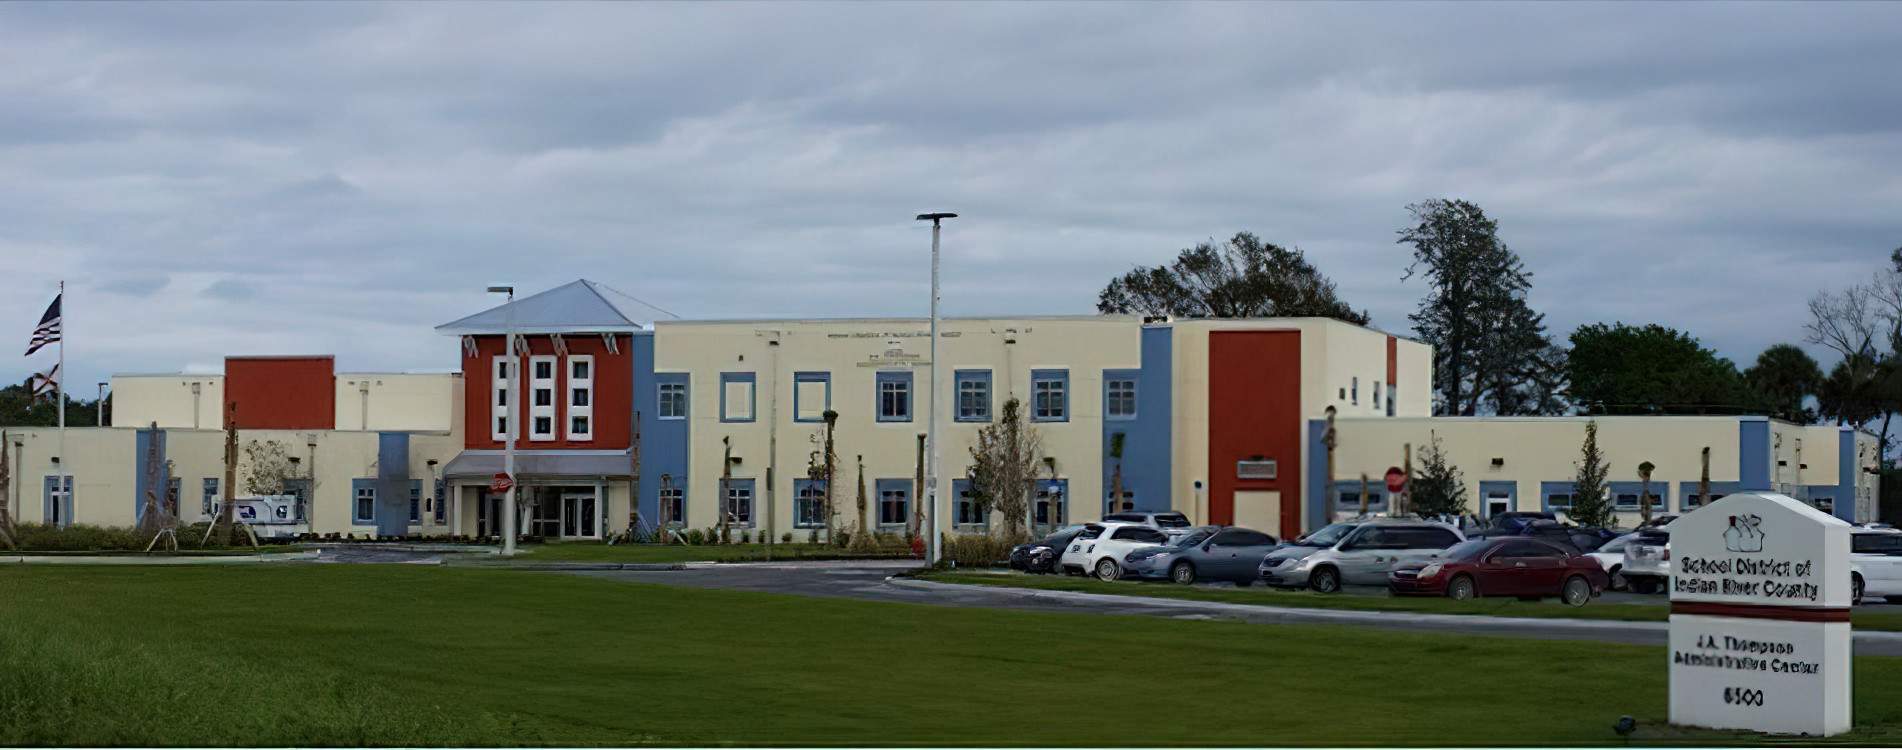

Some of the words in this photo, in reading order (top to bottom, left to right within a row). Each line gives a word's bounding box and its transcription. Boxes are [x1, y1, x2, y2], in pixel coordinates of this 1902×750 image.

[1682, 557, 1732, 575] School
[1736, 558, 1790, 577] District
[1795, 560, 1812, 576] of
[1722, 578, 1761, 596] River
